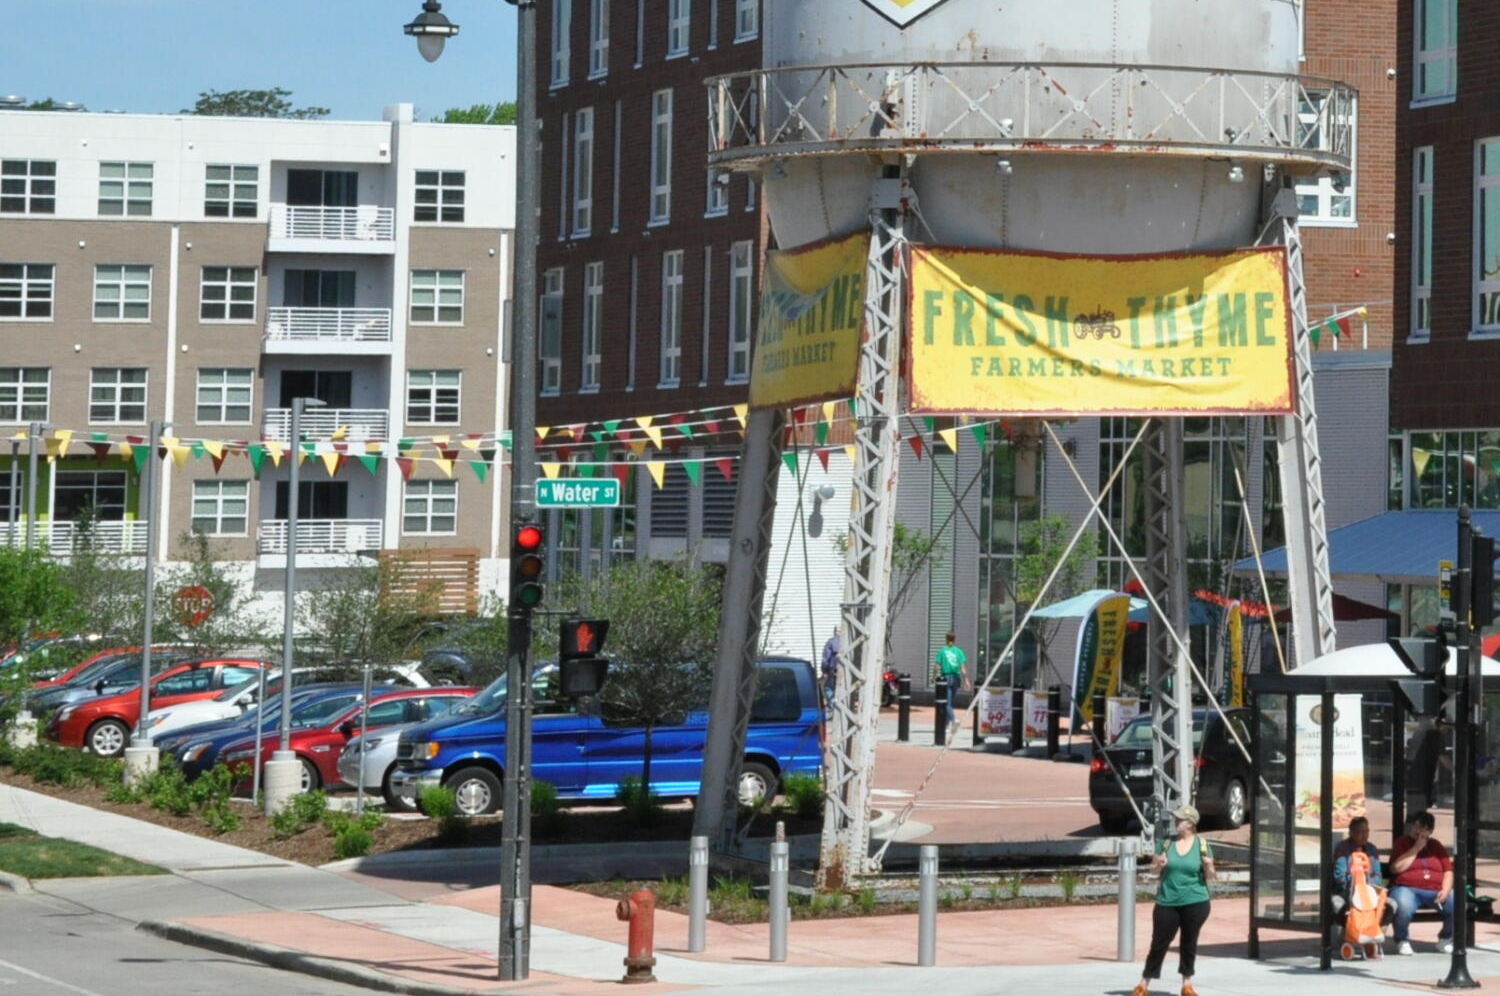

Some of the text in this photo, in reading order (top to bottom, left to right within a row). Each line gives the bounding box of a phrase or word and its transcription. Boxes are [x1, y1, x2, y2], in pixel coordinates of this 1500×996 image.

[923, 289, 1277, 349] FRESH THYME
[970, 355, 1232, 378] FARMERS MARKET
[540, 482, 615, 502] N Water ST
